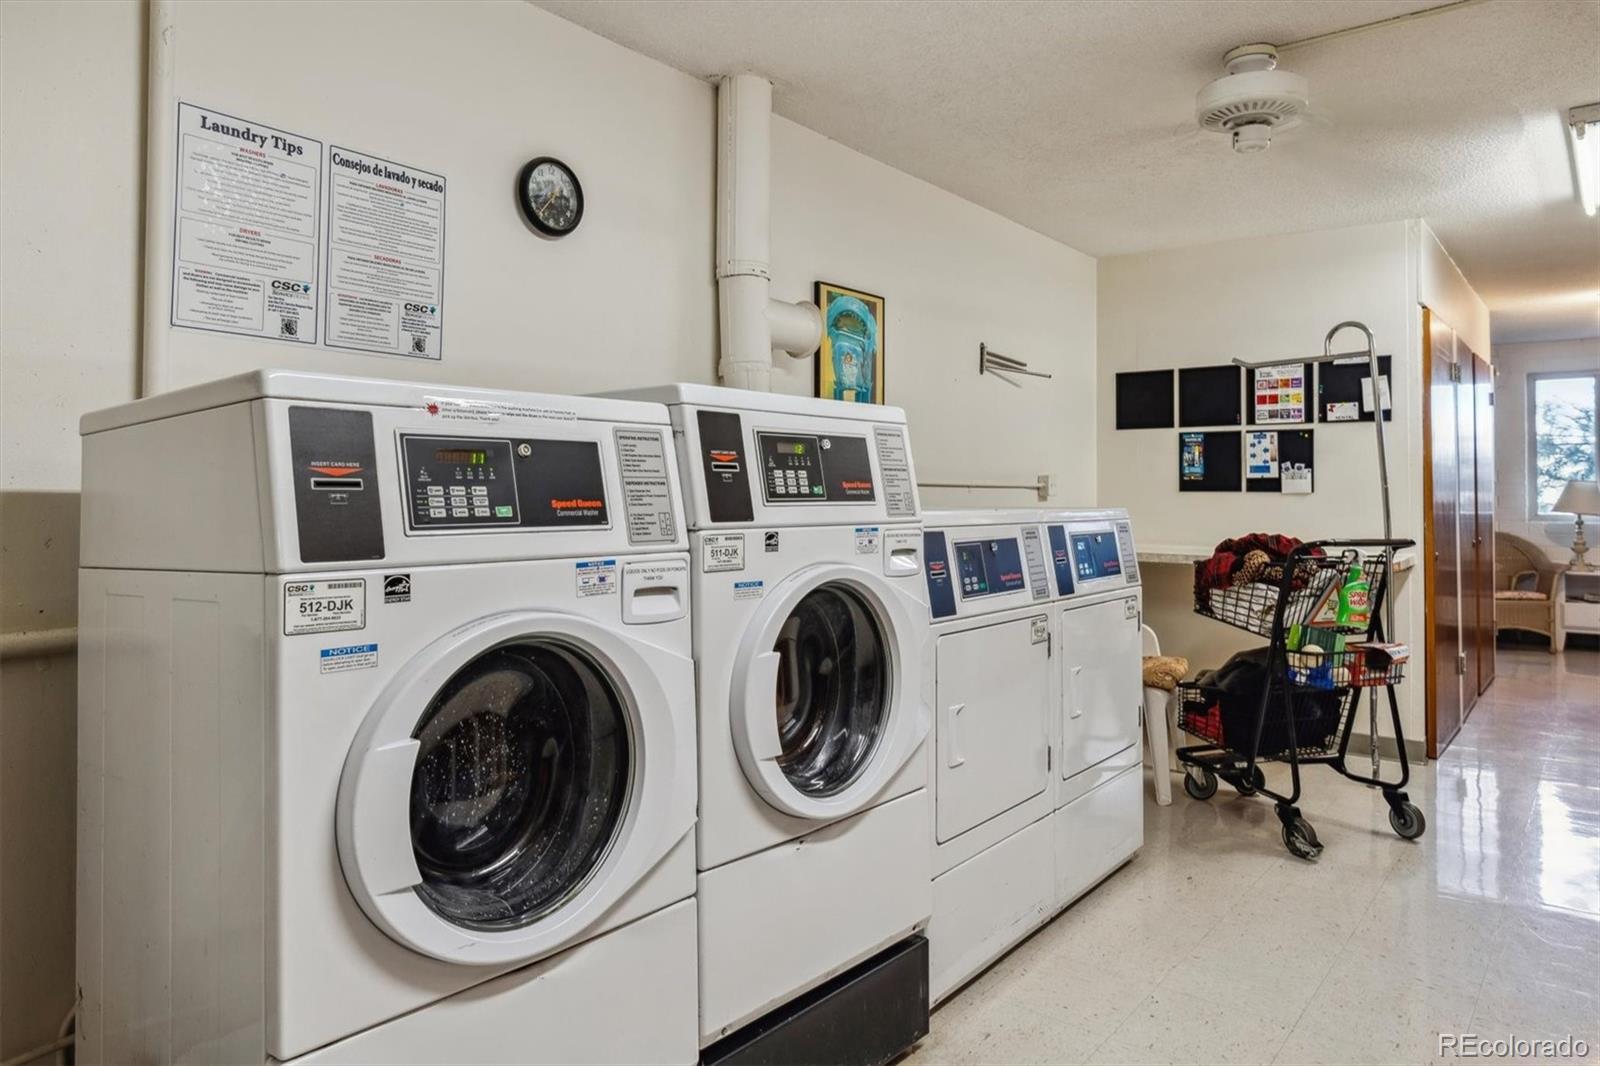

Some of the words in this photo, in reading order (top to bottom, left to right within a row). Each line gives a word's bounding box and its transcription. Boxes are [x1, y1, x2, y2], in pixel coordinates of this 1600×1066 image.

[200, 115, 268, 148] Laundry
[271, 135, 303, 157] Tips
[240, 147, 266, 158] WASHERS
[332, 152, 371, 174] Consejos
[372, 164, 383, 177] de
[384, 166, 410, 184] lavado
[411, 176, 417, 189] y
[418, 179, 443, 193] secado
[375, 183, 403, 194] LAVADORAS
[240, 227, 261, 236] DRYERS
[374, 254, 401, 264] SECADORAS
[271, 280, 301, 292] CSC
[404, 302, 429, 313] CSC
[552, 499, 576, 509] Speed
[577, 499, 602, 507] Queen
[711, 548, 738, 558] 511-DJK
[299, 599, 354, 614] 512-DJK
[329, 645, 369, 656] NOTICE
